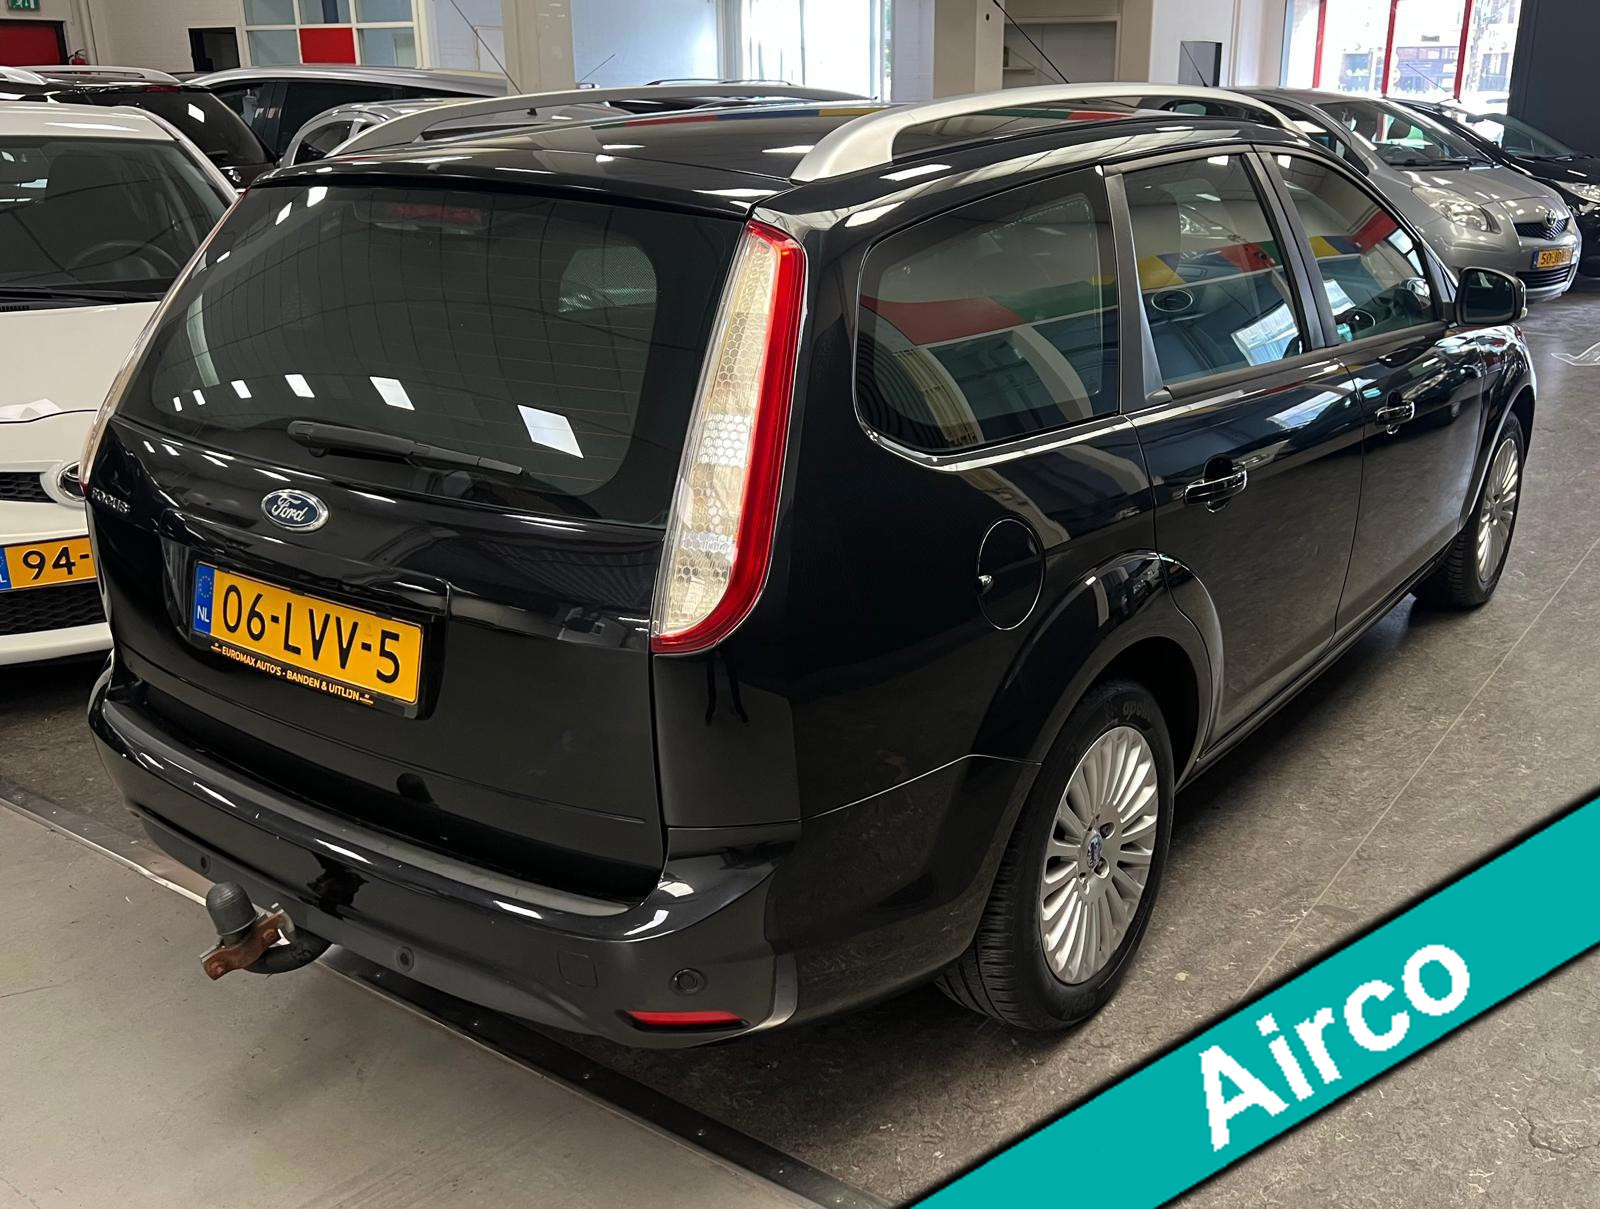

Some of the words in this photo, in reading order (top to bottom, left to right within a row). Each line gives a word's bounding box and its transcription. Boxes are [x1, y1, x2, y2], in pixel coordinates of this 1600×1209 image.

[91, 486, 131, 514] FOCUS
[271, 491, 309, 521] Ford
[196, 604, 211, 623] NL
[222, 583, 401, 685] 06-LVV-5
[221, 646, 256, 667] EUROMAX
[256, 659, 282, 676] AUTO'S
[286, 670, 321, 688] BANDEN
[321, 681, 328, 691] &
